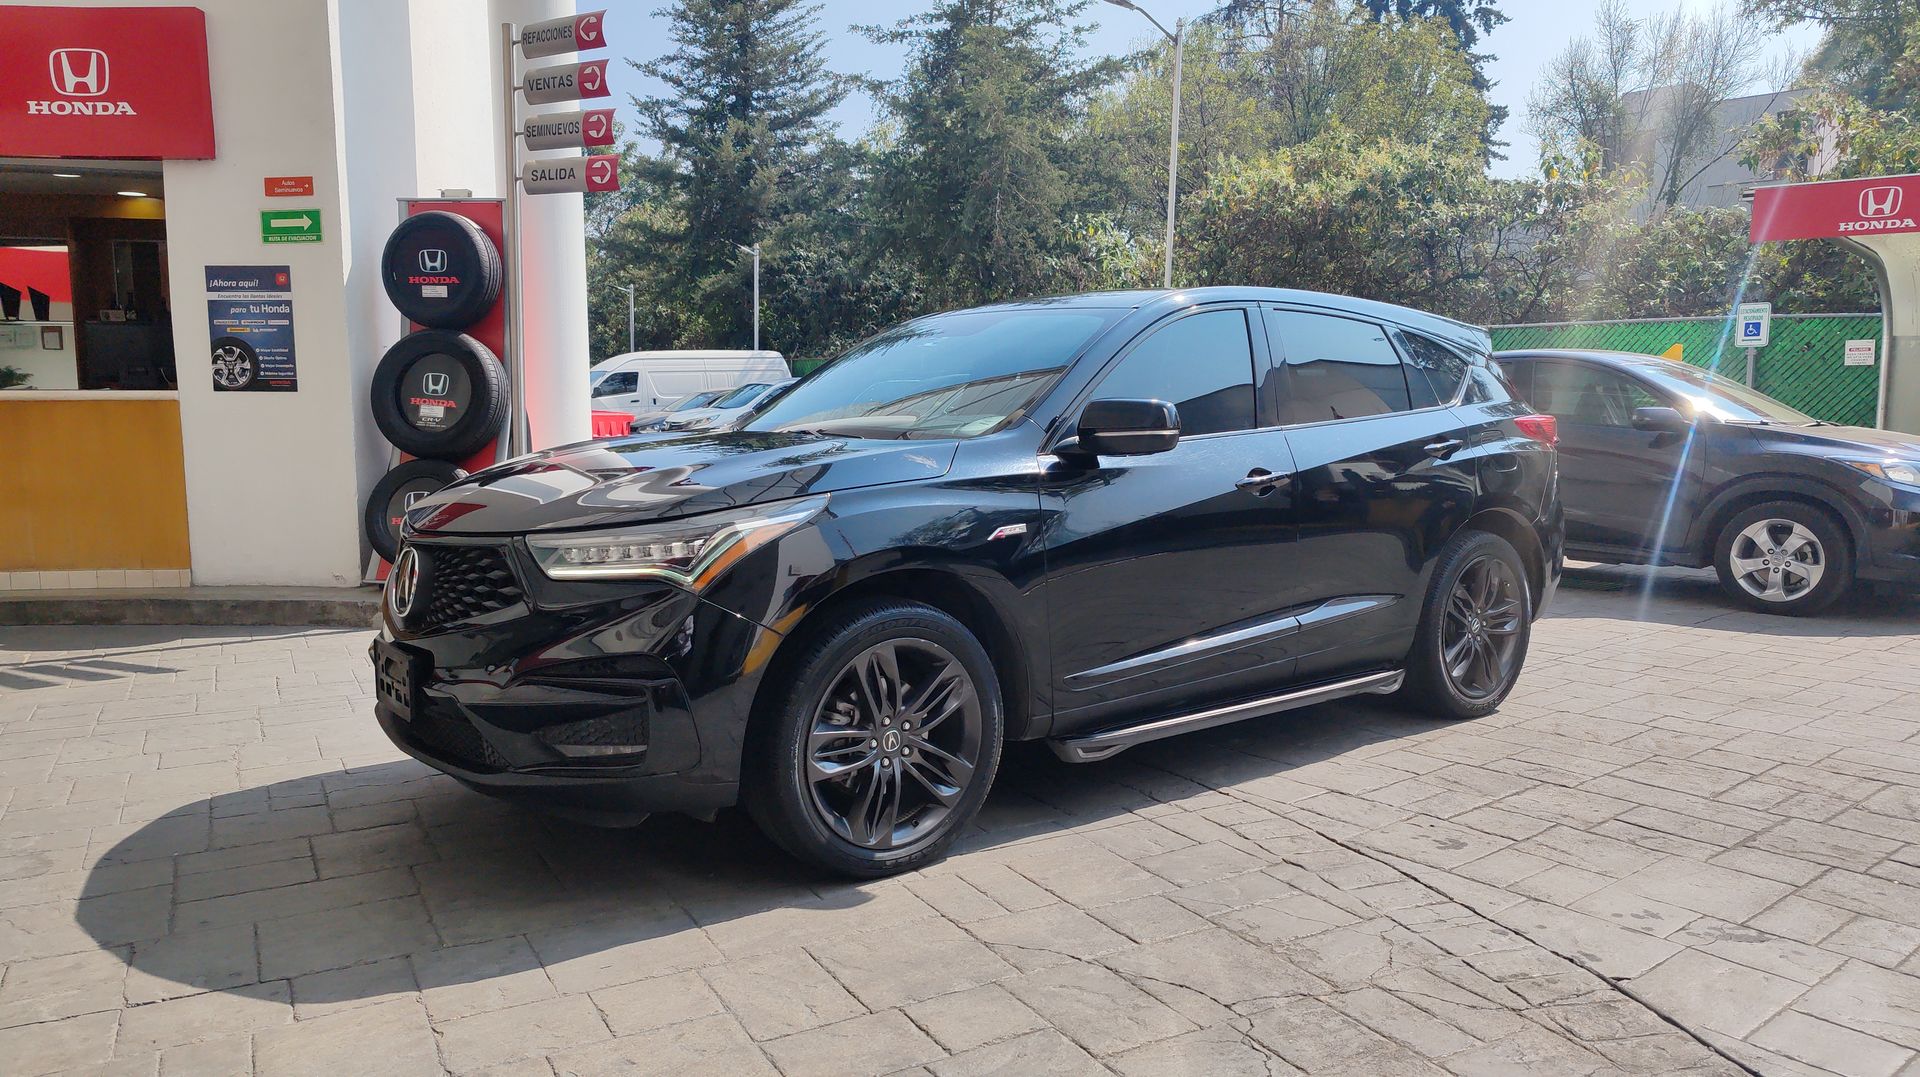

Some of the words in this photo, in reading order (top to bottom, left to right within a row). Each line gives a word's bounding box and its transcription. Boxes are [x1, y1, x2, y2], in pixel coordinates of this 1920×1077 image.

[522, 25, 573, 45] REFACCIONES
[528, 75, 573, 91] VENTAS
[26, 101, 137, 115] HONDA
[526, 121, 580, 138] SEMINUEVOS
[531, 167, 576, 182] SALIDA
[1838, 218, 1917, 232] HONDA
[209, 279, 237, 288] ¡Ahora
[238, 279, 259, 289] aquí!
[407, 276, 460, 284] HONDA
[249, 304, 260, 313] tu
[261, 304, 290, 313] Honda
[409, 397, 457, 408] HONDA
